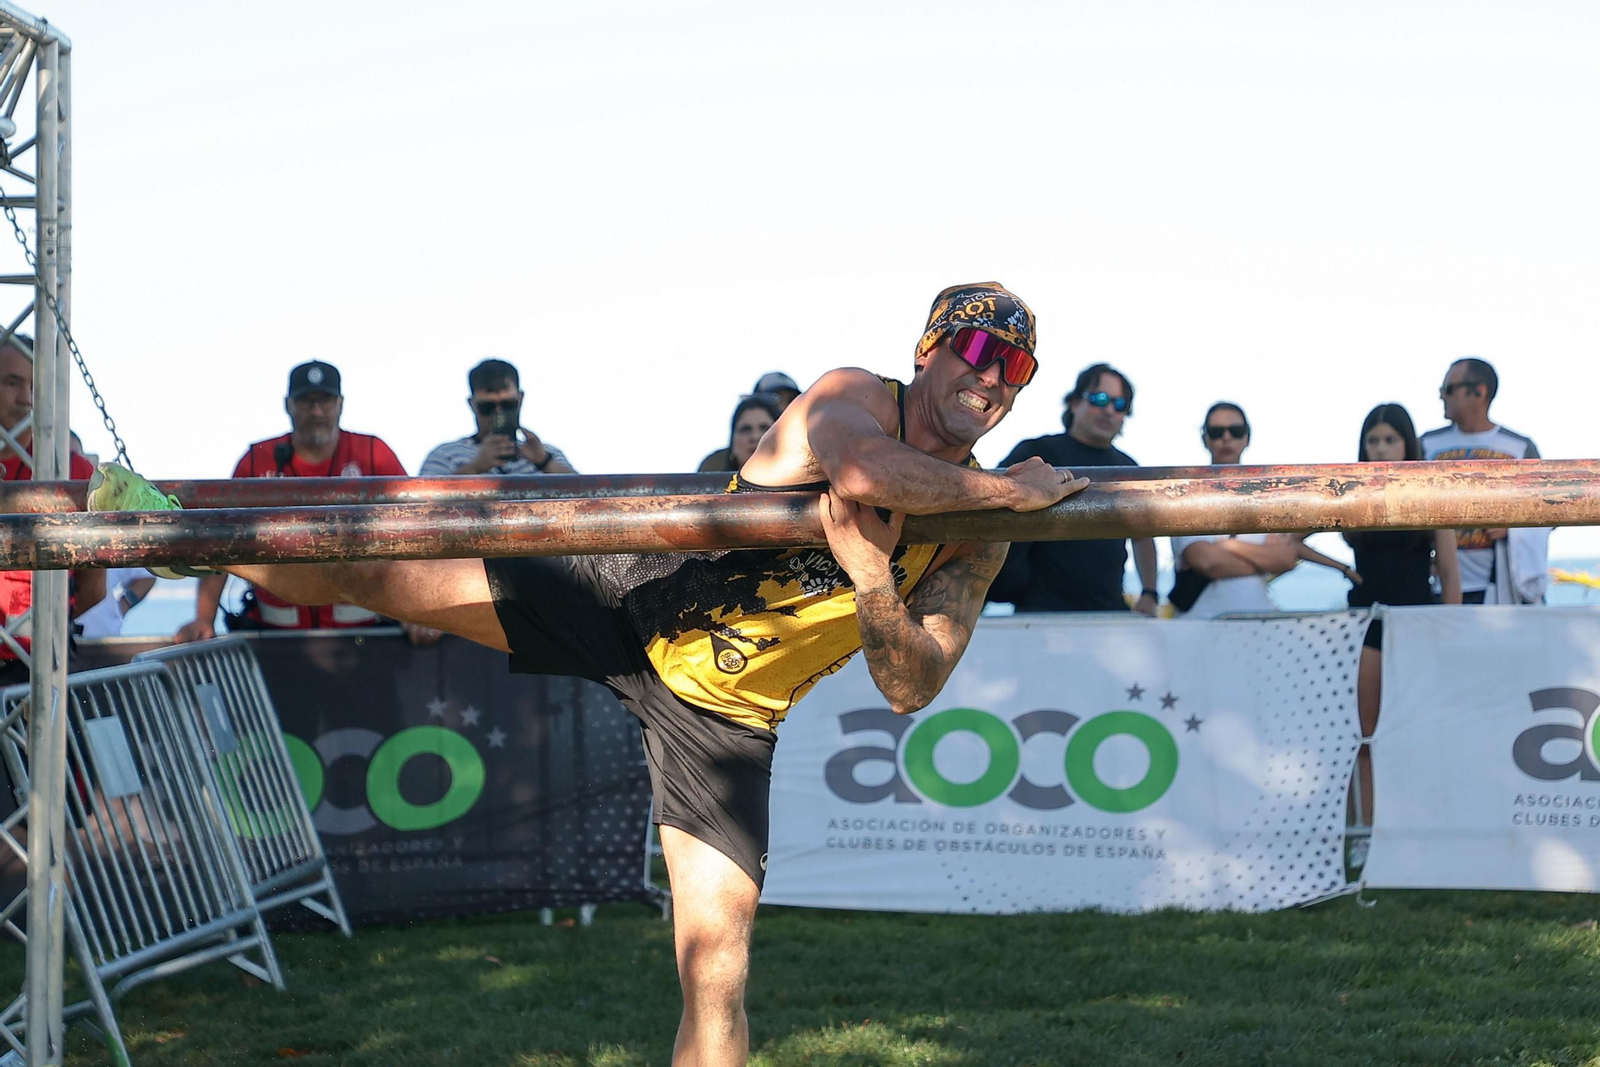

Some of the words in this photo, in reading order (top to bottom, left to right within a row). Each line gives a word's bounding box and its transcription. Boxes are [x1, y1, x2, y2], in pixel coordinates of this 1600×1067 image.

[827, 817, 946, 833] ASOCIACIÓN
[952, 820, 977, 835] DE
[983, 820, 1147, 841] ORGANIZADORES
[1154, 827, 1167, 841] Y
[1512, 811, 1582, 827] CLUBES
[825, 836, 897, 850] CLUBES
[902, 837, 927, 851] DE
[933, 837, 1057, 857] OBSTÁCULOS
[1062, 843, 1088, 858] DE
[1093, 843, 1168, 860] ESPAÑA
